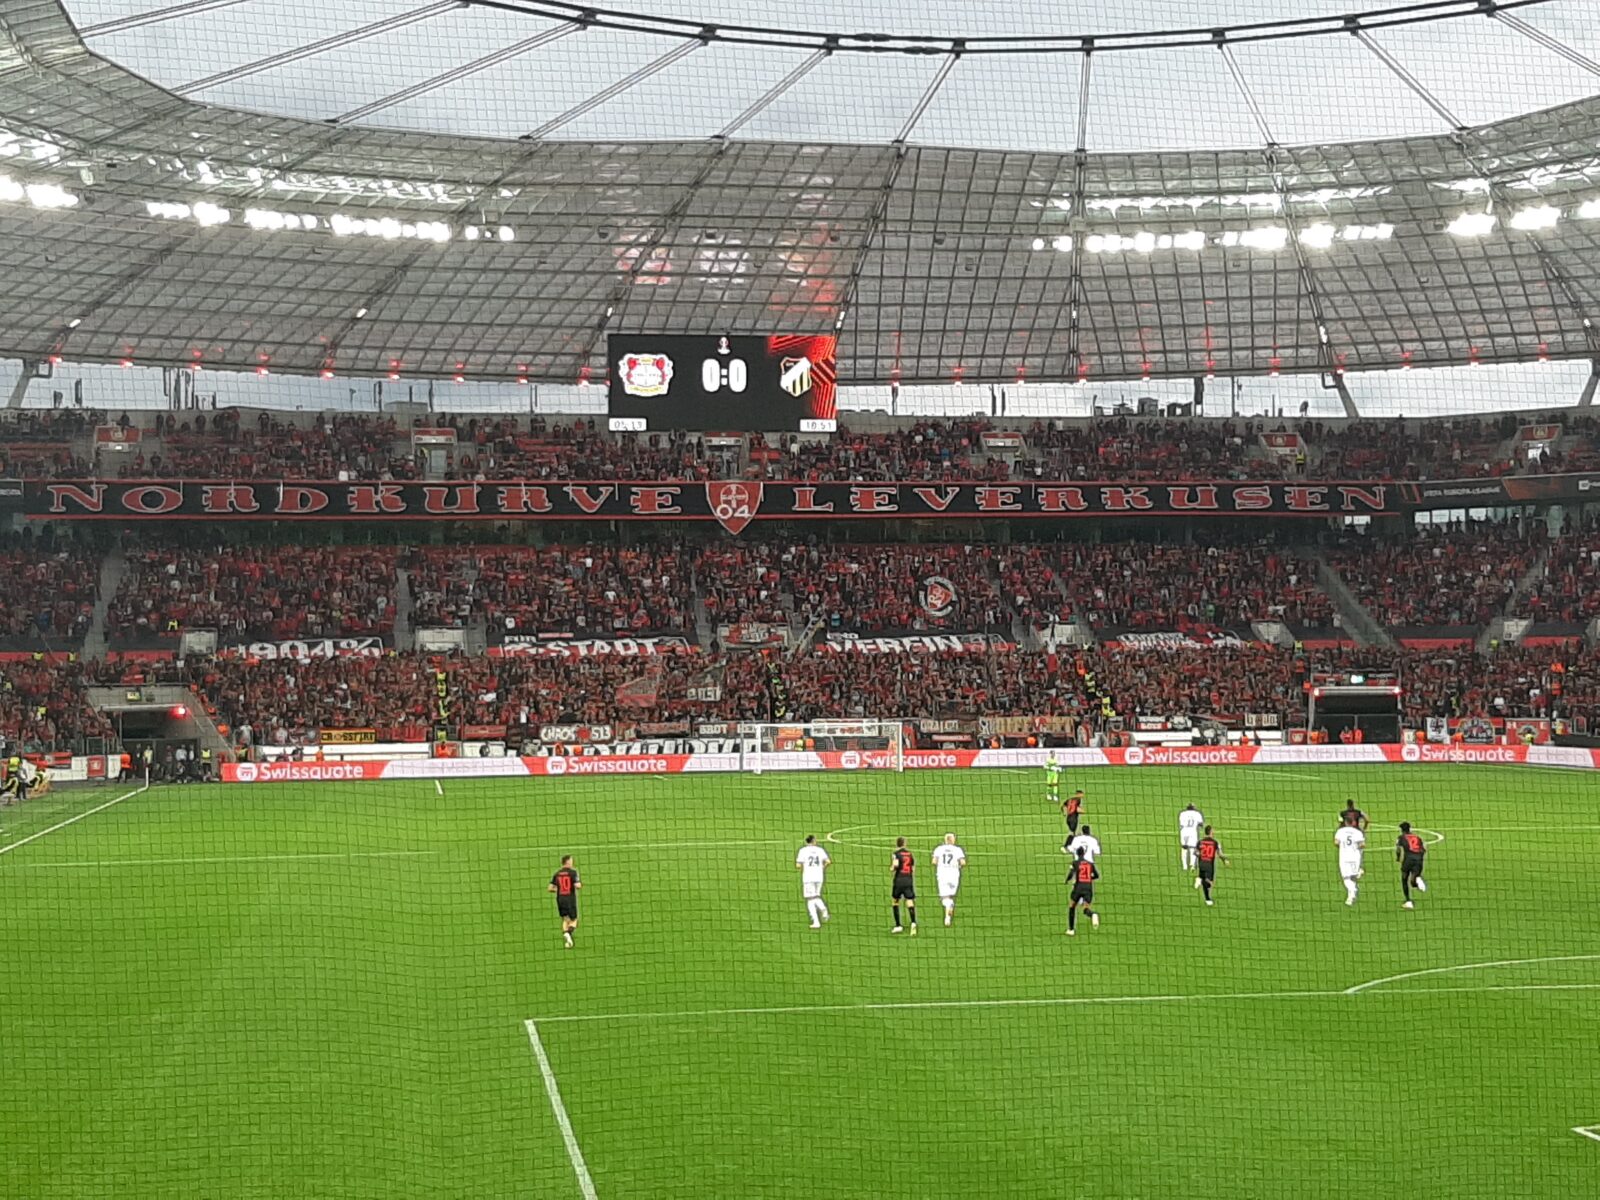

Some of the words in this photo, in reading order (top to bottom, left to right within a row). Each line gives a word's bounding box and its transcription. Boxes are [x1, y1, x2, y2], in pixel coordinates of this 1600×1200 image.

[702, 358, 747, 393] 0:0
[47, 484, 682, 514] NORDKURVE
[792, 486, 1386, 512] LEVERKUSEN
[716, 504, 753, 519] 04
[861, 751, 957, 768] Swissquote
[1145, 748, 1239, 764] Swissquote
[1421, 745, 1515, 762] Swissquote
[259, 763, 364, 781] Swissquote
[568, 757, 668, 773] Swissquote
[1346, 836, 1353, 846] 5
[1407, 834, 1420, 849] 12
[1201, 844, 1214, 859] 20
[808, 855, 820, 867] 24
[902, 855, 911, 870] 2
[1078, 866, 1092, 882] 21
[558, 876, 571, 891] 10
